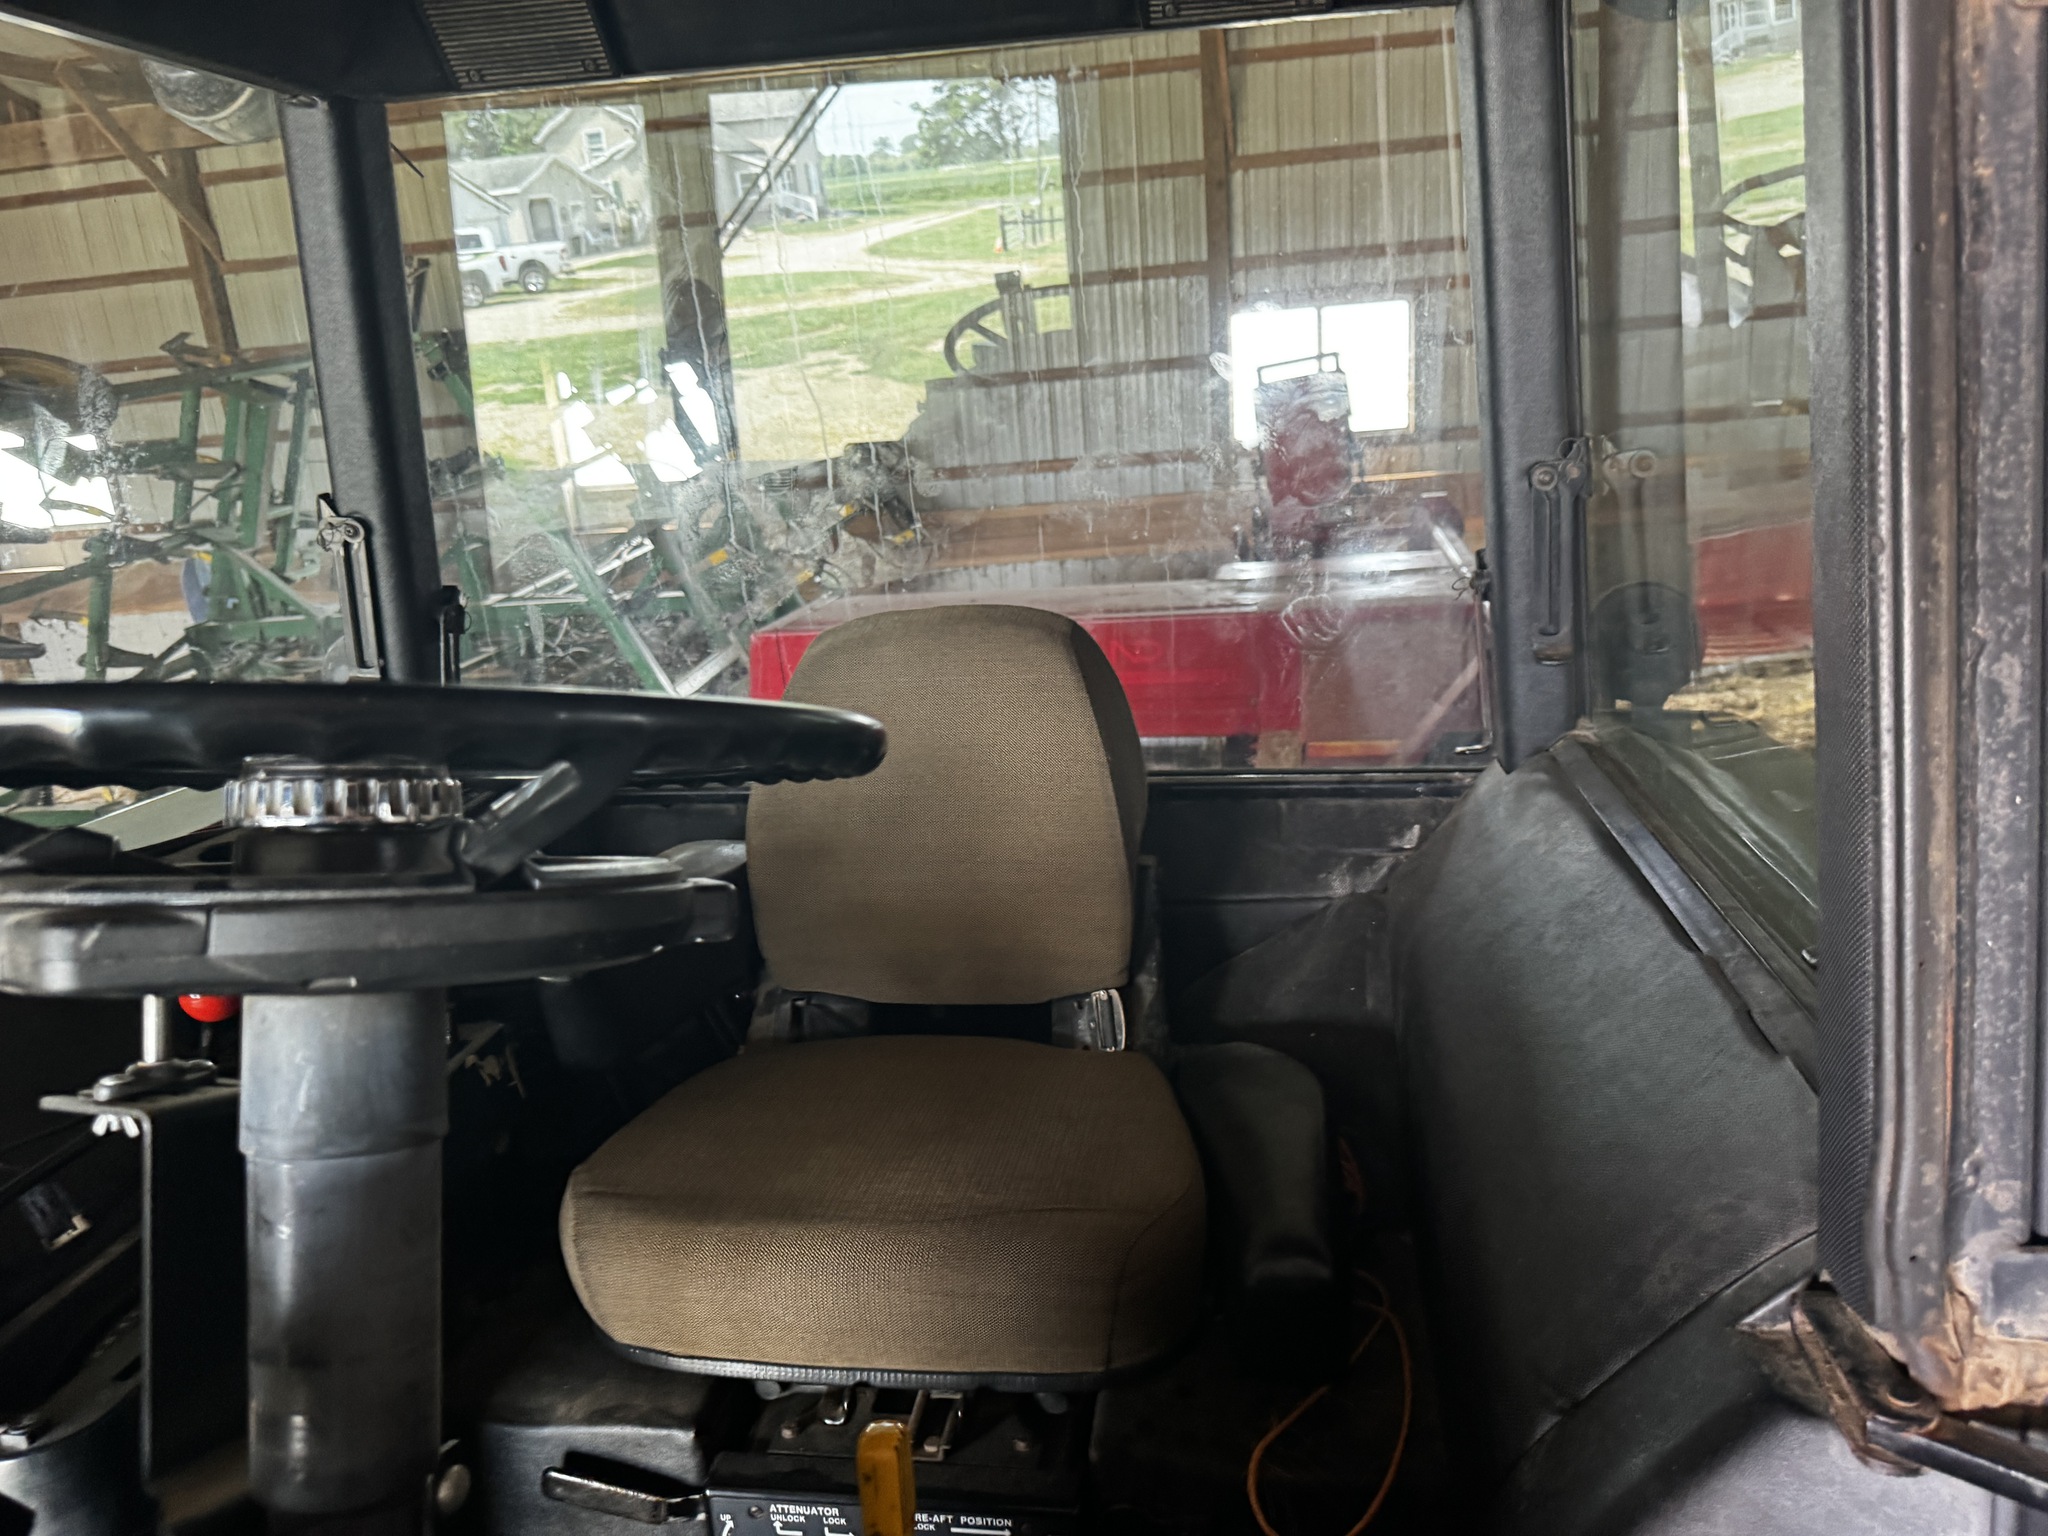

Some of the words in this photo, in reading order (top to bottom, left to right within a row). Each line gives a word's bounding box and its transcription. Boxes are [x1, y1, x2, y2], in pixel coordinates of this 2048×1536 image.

[769, 1504, 839, 1516] ATTENUATOR
[770, 1514, 805, 1522] UNLOCK
[823, 1517, 846, 1525] LOCK
[914, 1513, 953, 1523] RE-AFT
[960, 1516, 1012, 1527] POSITION
[914, 1523, 935, 1531] OCK
